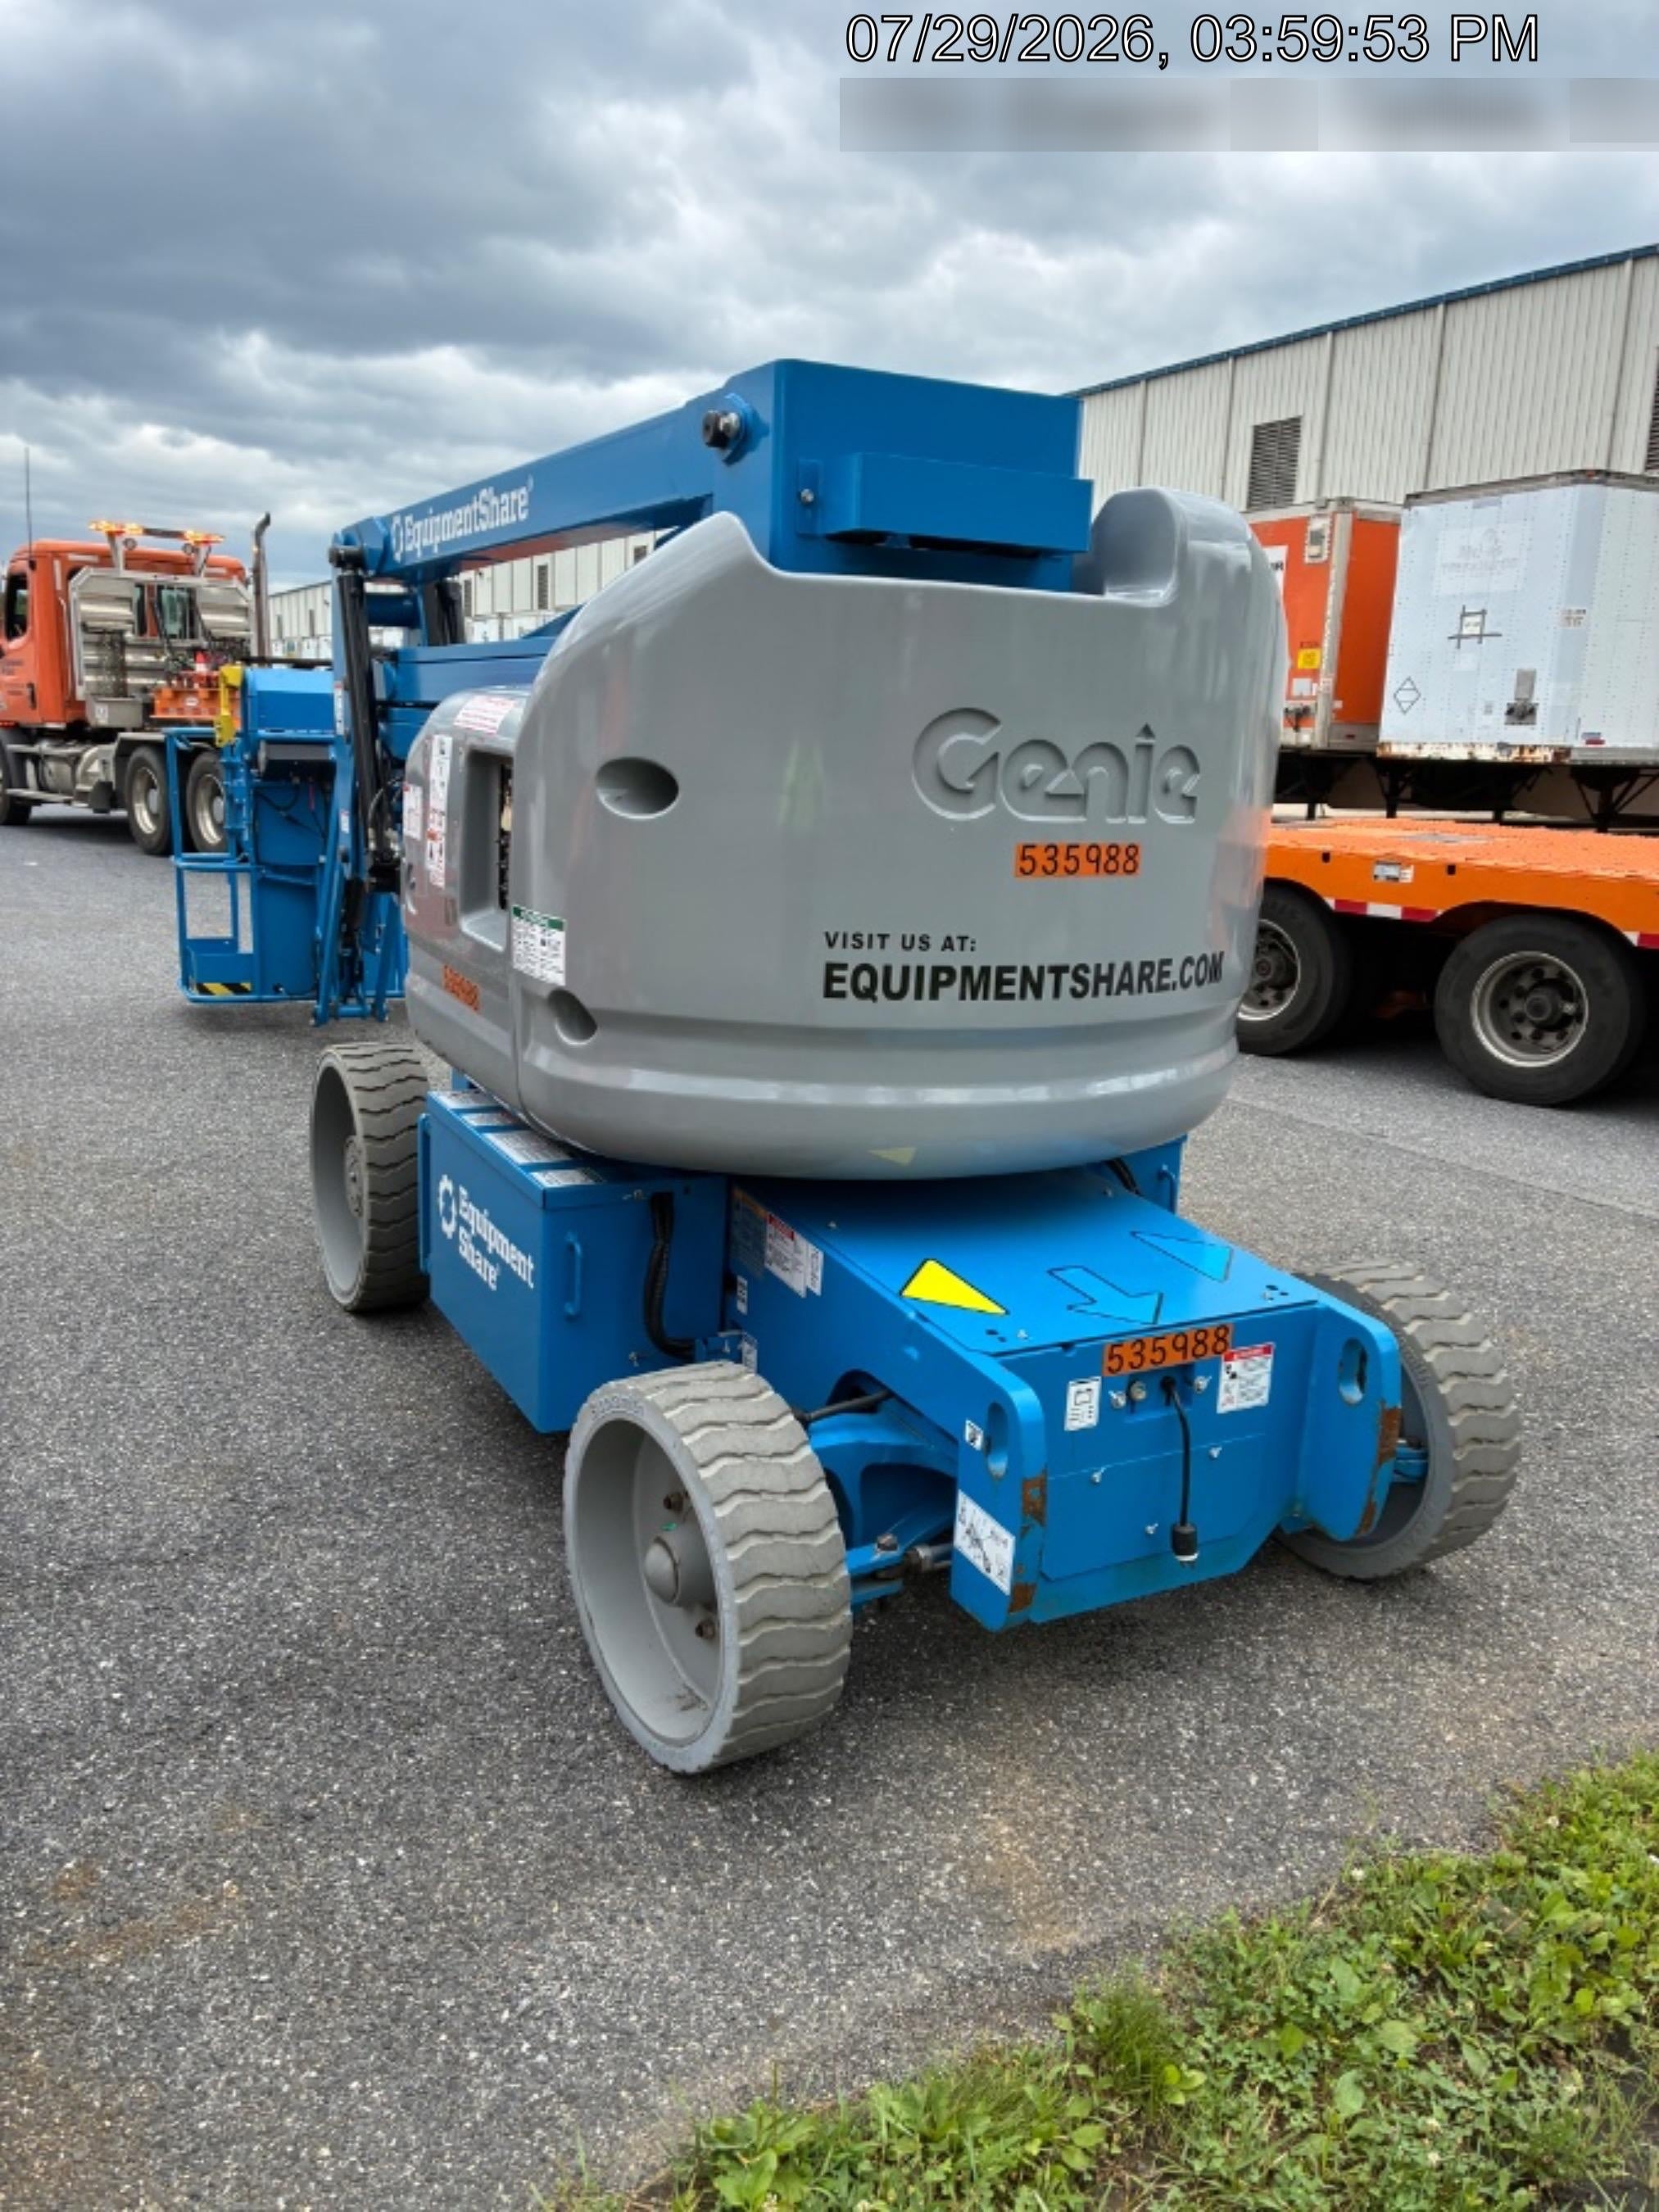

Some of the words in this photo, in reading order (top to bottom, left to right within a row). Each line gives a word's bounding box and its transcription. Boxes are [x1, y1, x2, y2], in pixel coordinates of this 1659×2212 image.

[911, 706, 1200, 824] Genie
[1018, 843, 1140, 876] 535988
[824, 931, 891, 950] VISIT
[901, 933, 931, 952] US
[940, 933, 977, 953] AT:
[823, 950, 1225, 1003] EQUIPMENTSHARE.COM
[458, 1183, 535, 1290] Equipment
[458, 1225, 498, 1291] Share
[1106, 1323, 1231, 1376] 535988
